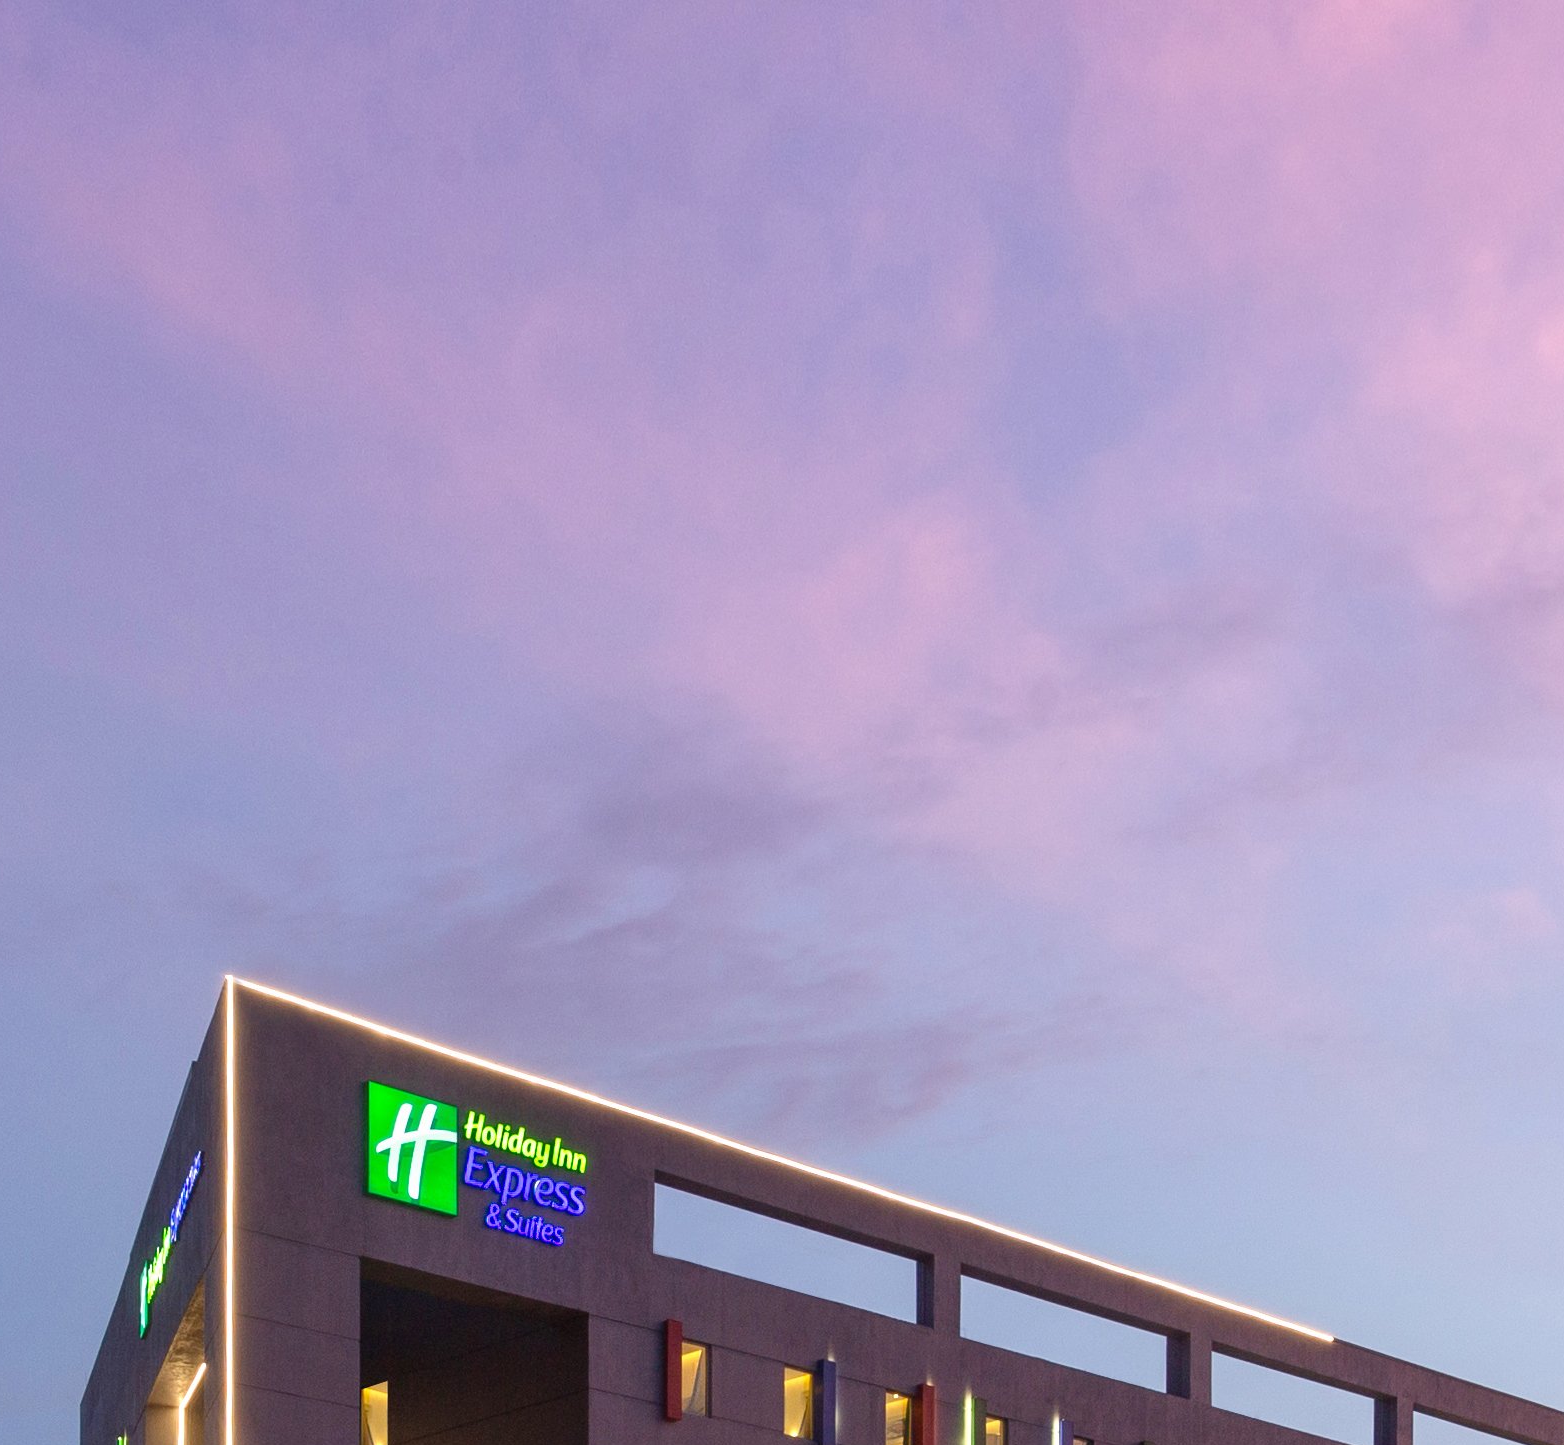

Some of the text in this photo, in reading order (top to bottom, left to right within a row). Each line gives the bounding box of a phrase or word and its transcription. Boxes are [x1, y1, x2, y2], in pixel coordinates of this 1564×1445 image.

[464, 1110, 587, 1174] Holiday Inn
[463, 1145, 586, 1216] Express
[485, 1202, 565, 1247] & Suites
